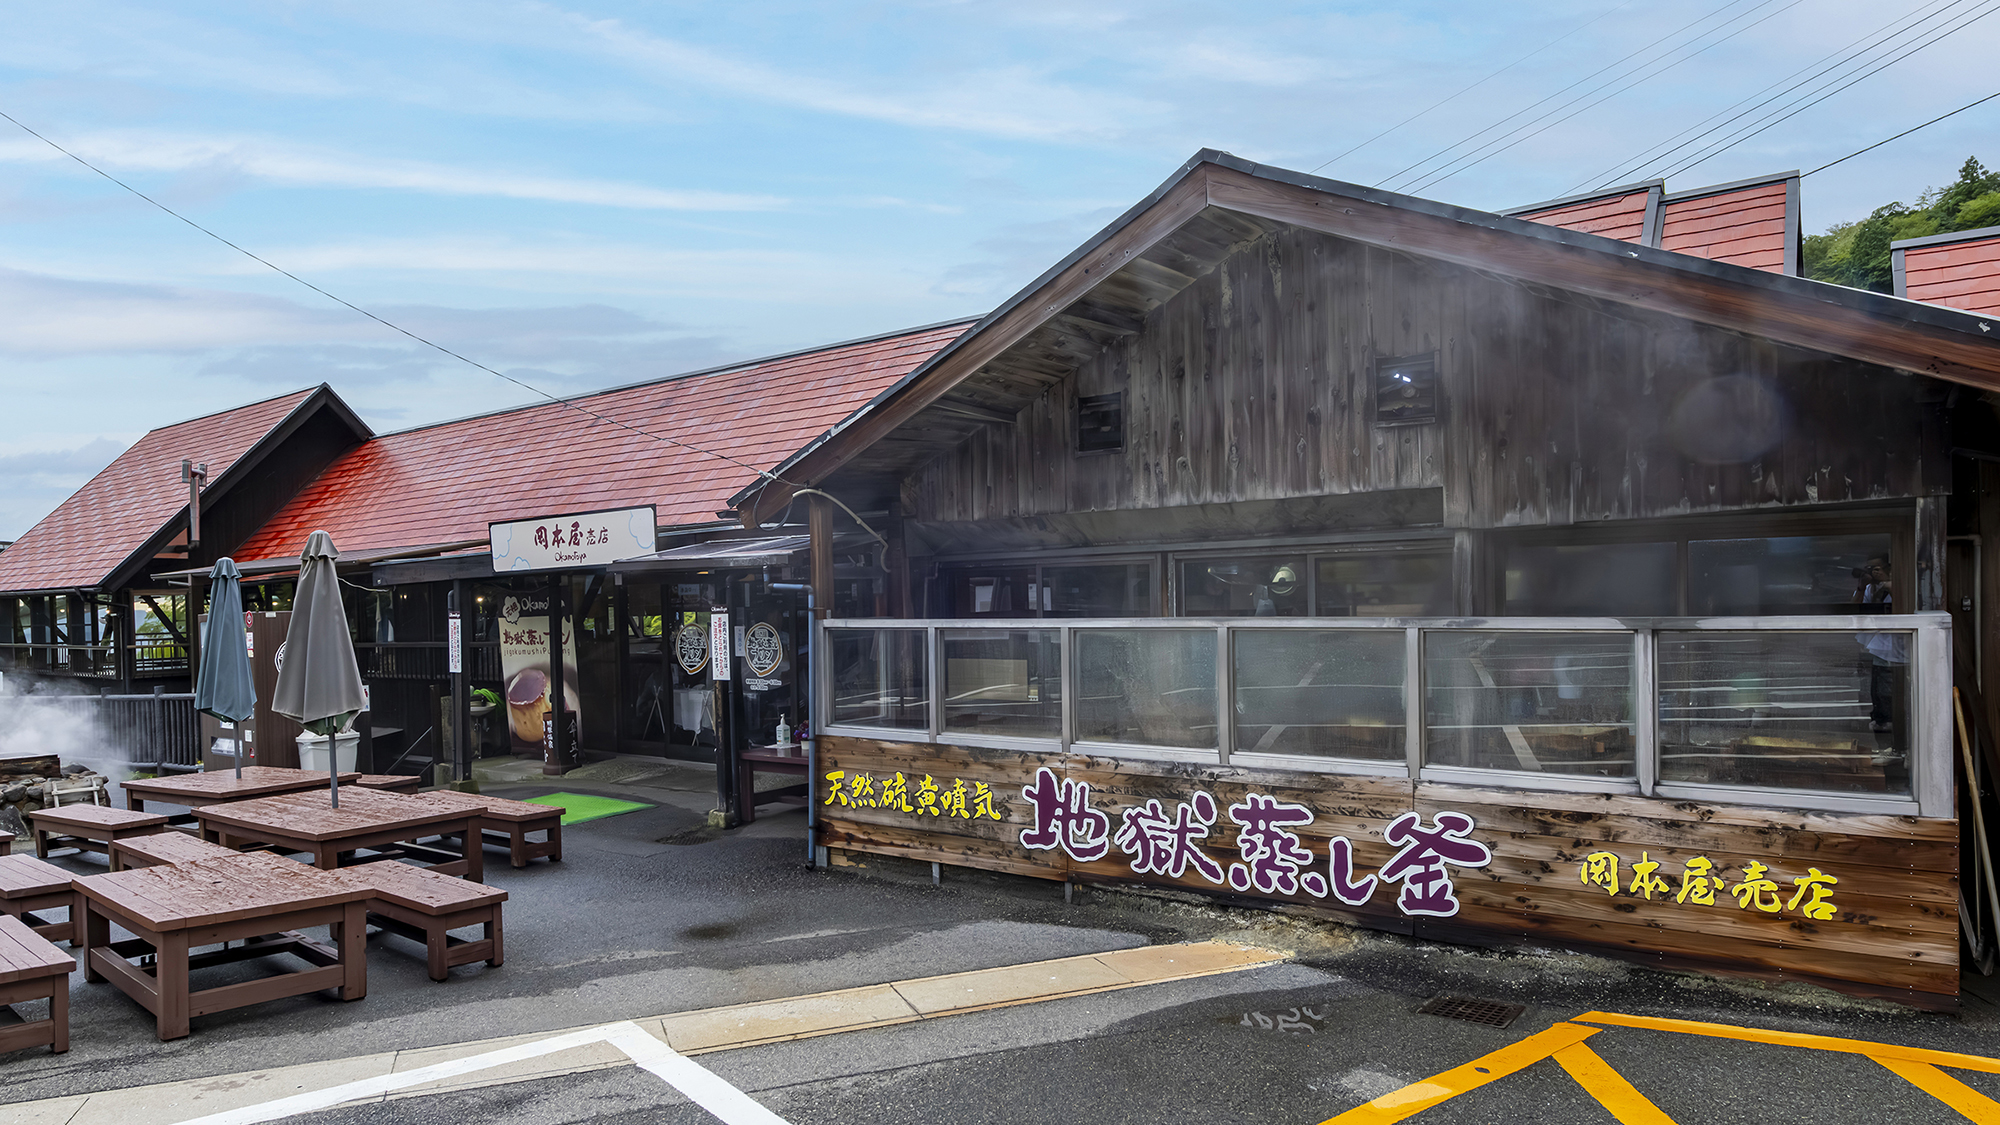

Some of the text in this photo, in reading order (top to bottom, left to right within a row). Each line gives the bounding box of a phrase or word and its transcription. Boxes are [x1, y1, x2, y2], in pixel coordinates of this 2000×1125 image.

[534, 521, 609, 550] 岡本屋売店
[824, 770, 1002, 821] 天然硫黄噴気
[1018, 766, 1492, 919] 地獄蒸し釜
[1580, 850, 1839, 922] 岡本屋売店
